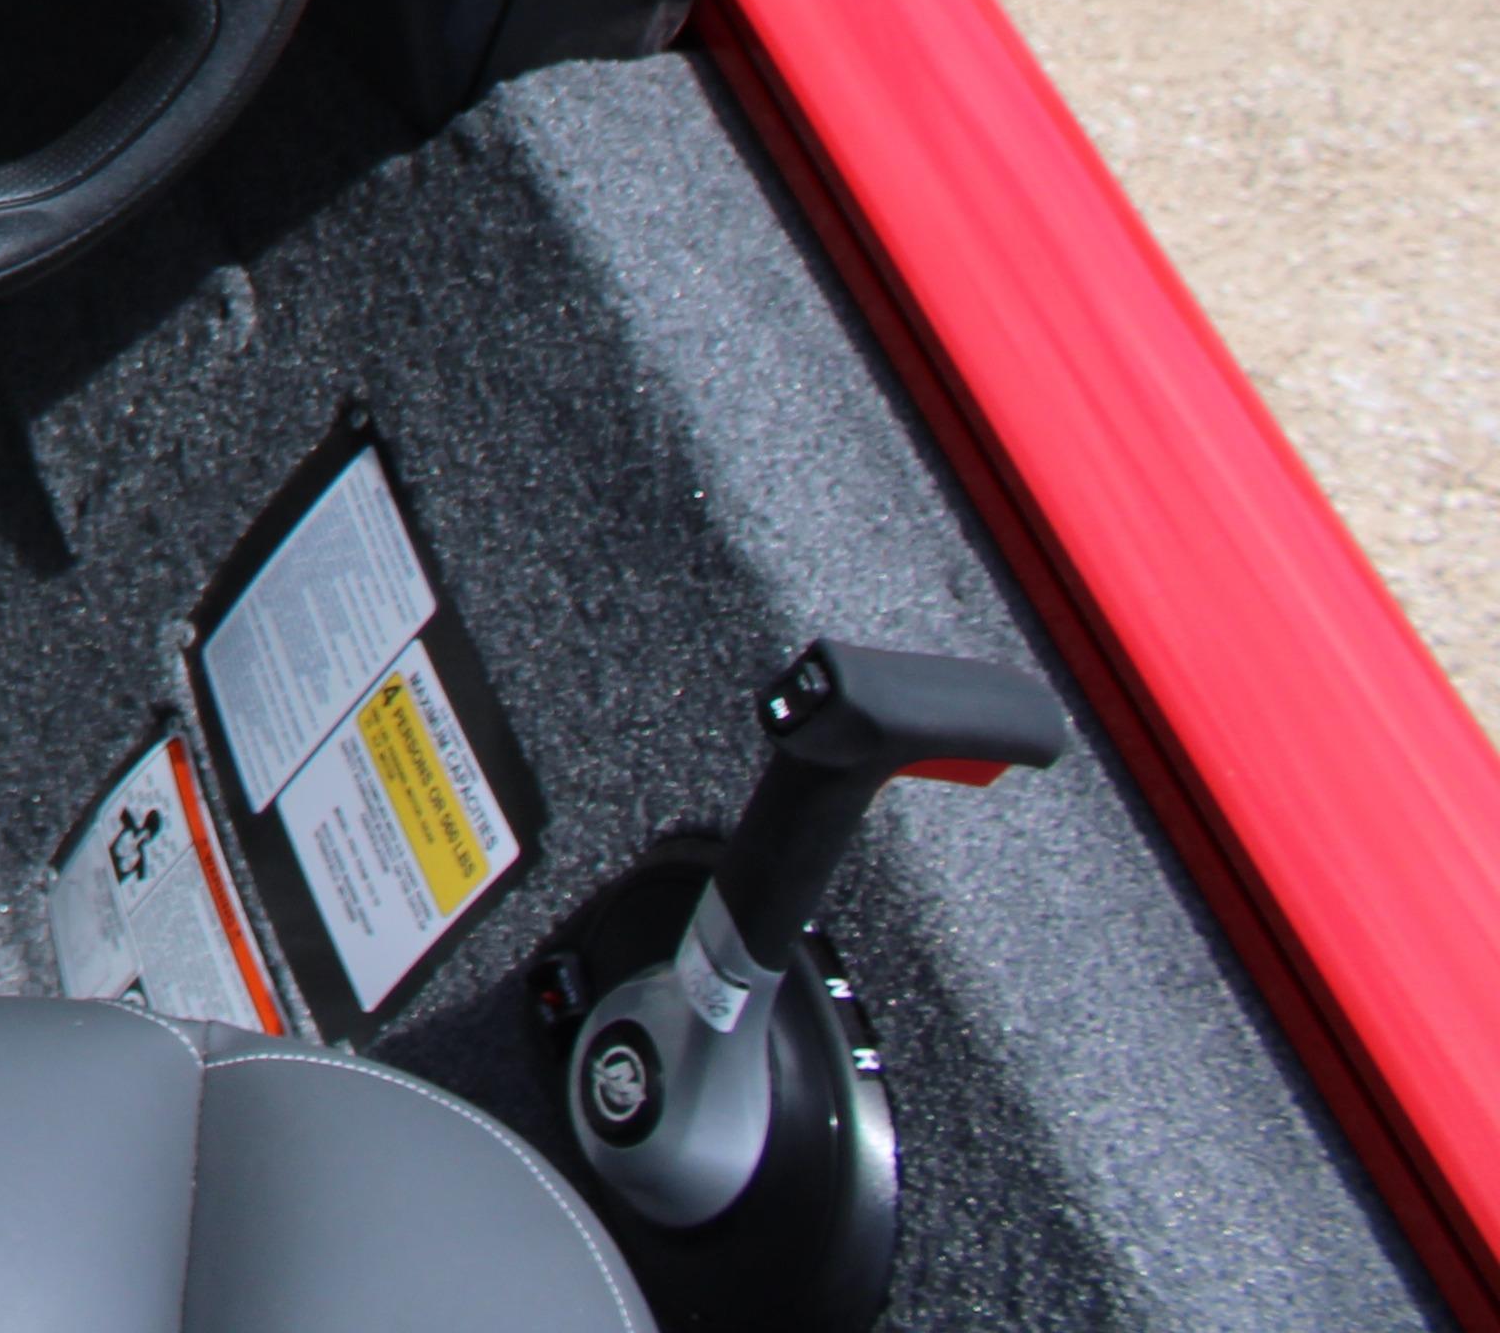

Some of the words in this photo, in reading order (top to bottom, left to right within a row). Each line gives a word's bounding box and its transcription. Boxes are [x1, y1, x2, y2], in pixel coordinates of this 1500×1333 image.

[381, 682, 403, 709] 4
[391, 703, 435, 788] PERSONS
[427, 781, 448, 816] OR
[443, 746, 499, 853] CAPACITIES
[451, 837, 478, 881] LBS
